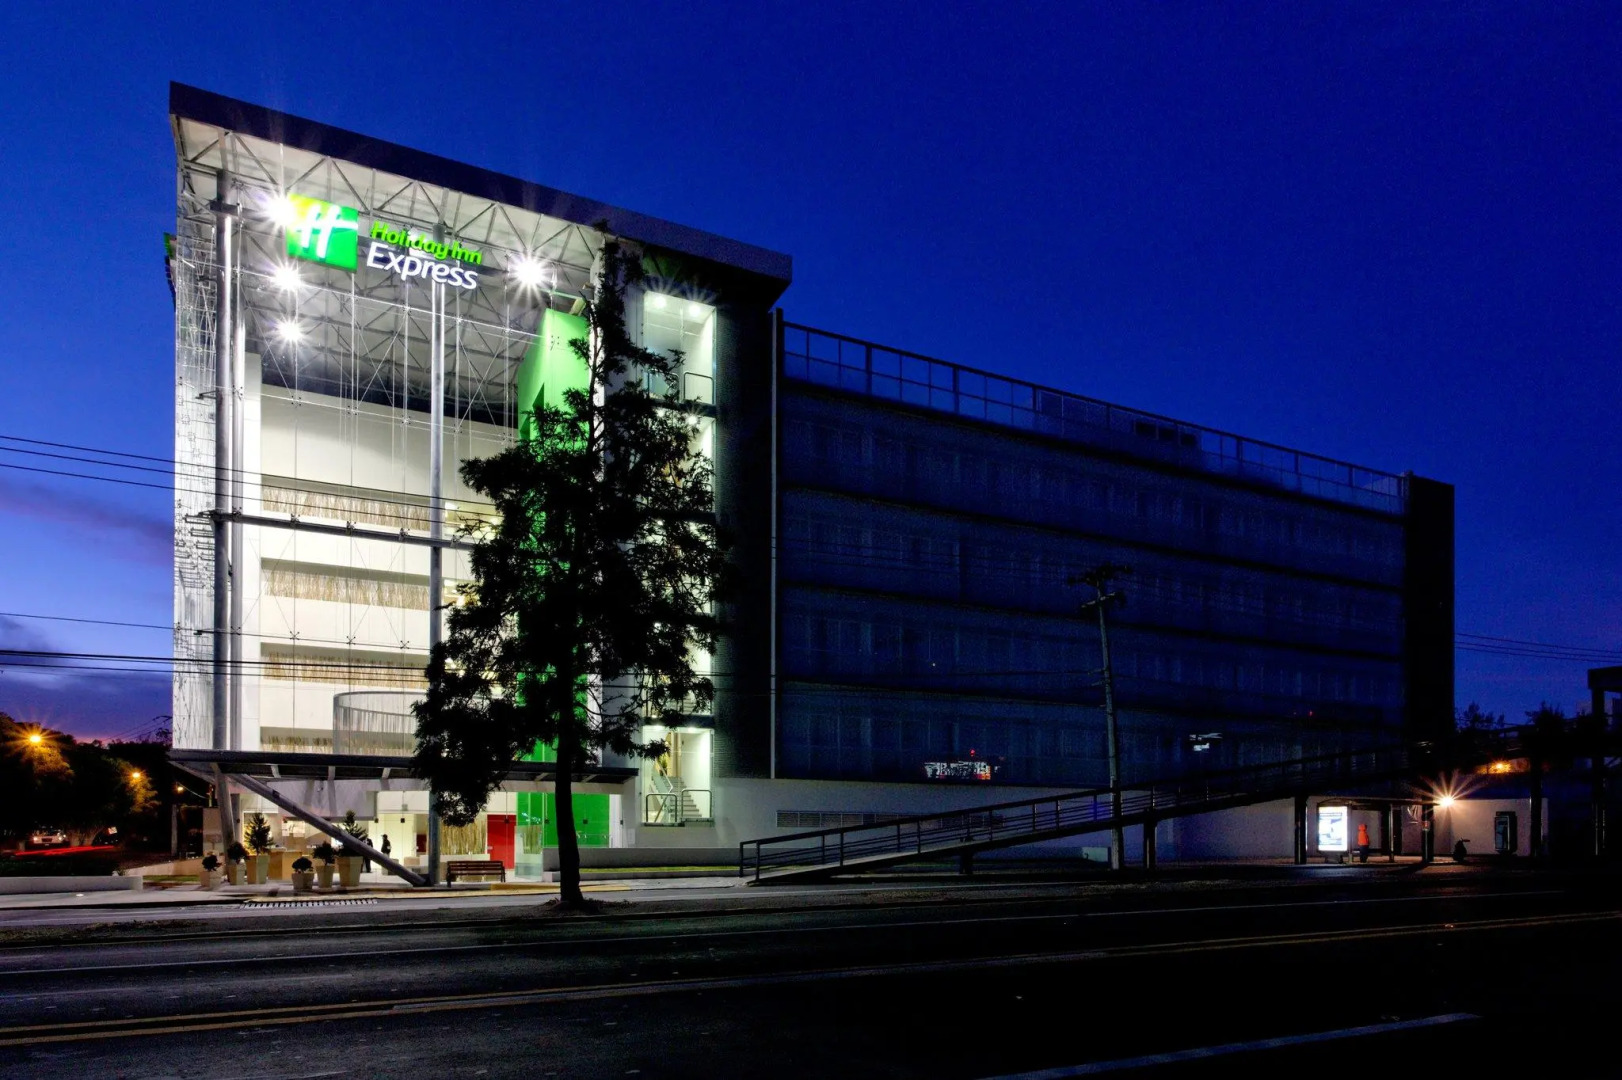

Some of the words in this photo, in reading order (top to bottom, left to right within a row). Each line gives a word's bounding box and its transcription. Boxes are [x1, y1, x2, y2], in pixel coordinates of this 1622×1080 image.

[366, 241, 479, 290] Express
[371, 219, 450, 260] Holiday
[452, 240, 482, 265] Inn
